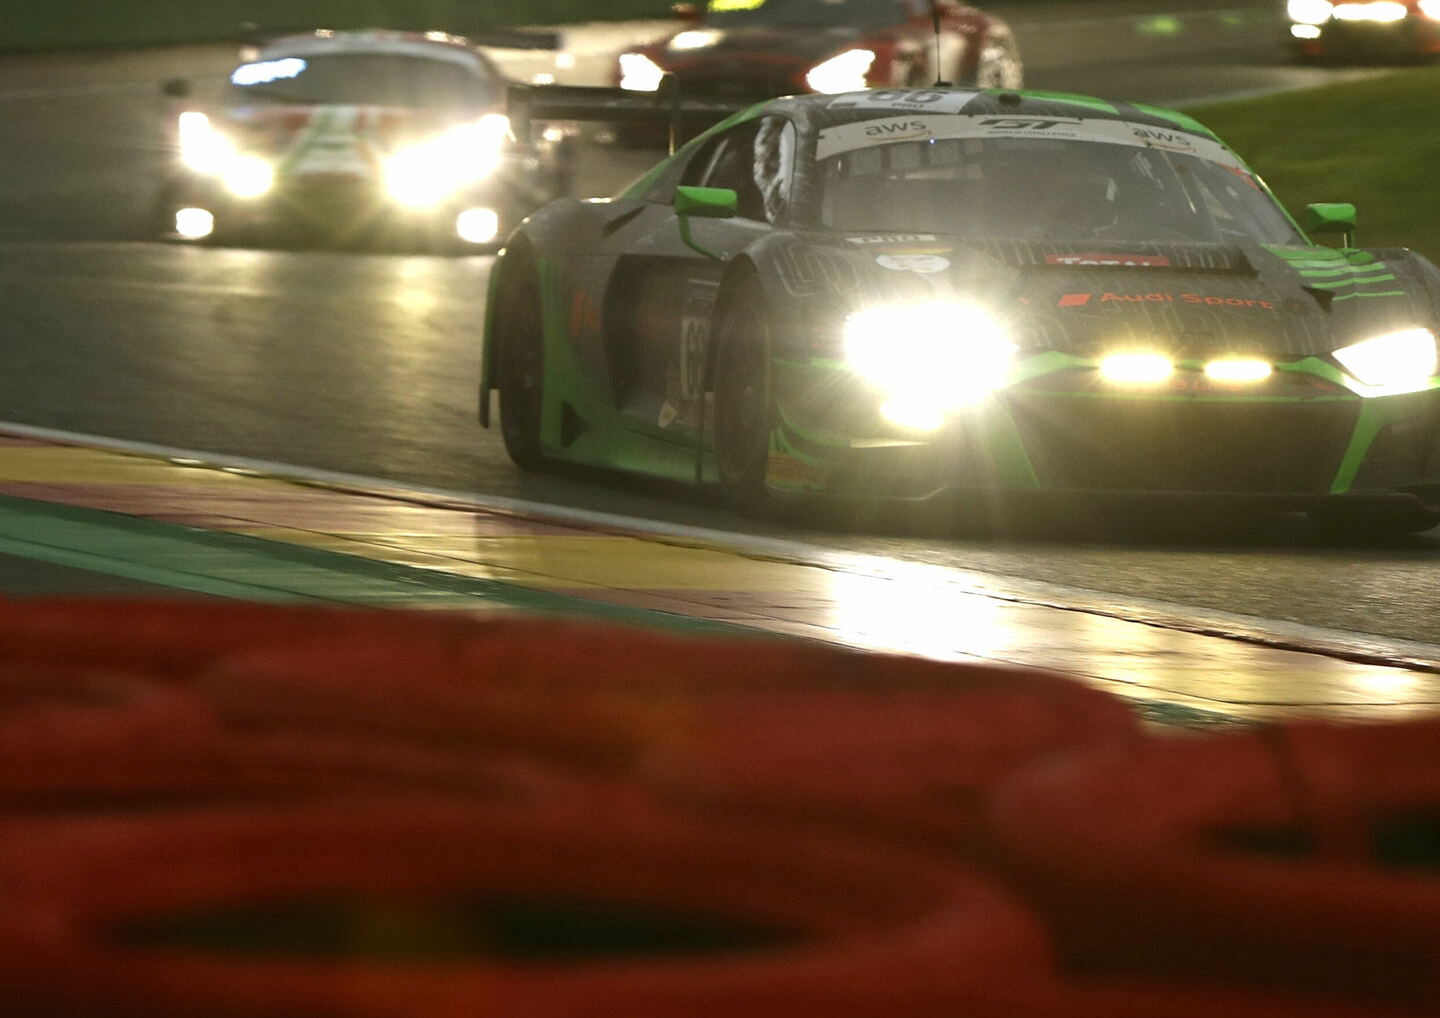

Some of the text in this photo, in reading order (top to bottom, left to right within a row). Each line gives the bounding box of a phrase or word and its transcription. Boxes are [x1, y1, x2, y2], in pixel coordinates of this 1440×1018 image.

[865, 121, 926, 136] aws
[979, 118, 1082, 130] GT
[1132, 128, 1191, 146] aws
[1056, 257, 1151, 267] TOT
[1101, 292, 1275, 310] Audi Sport
